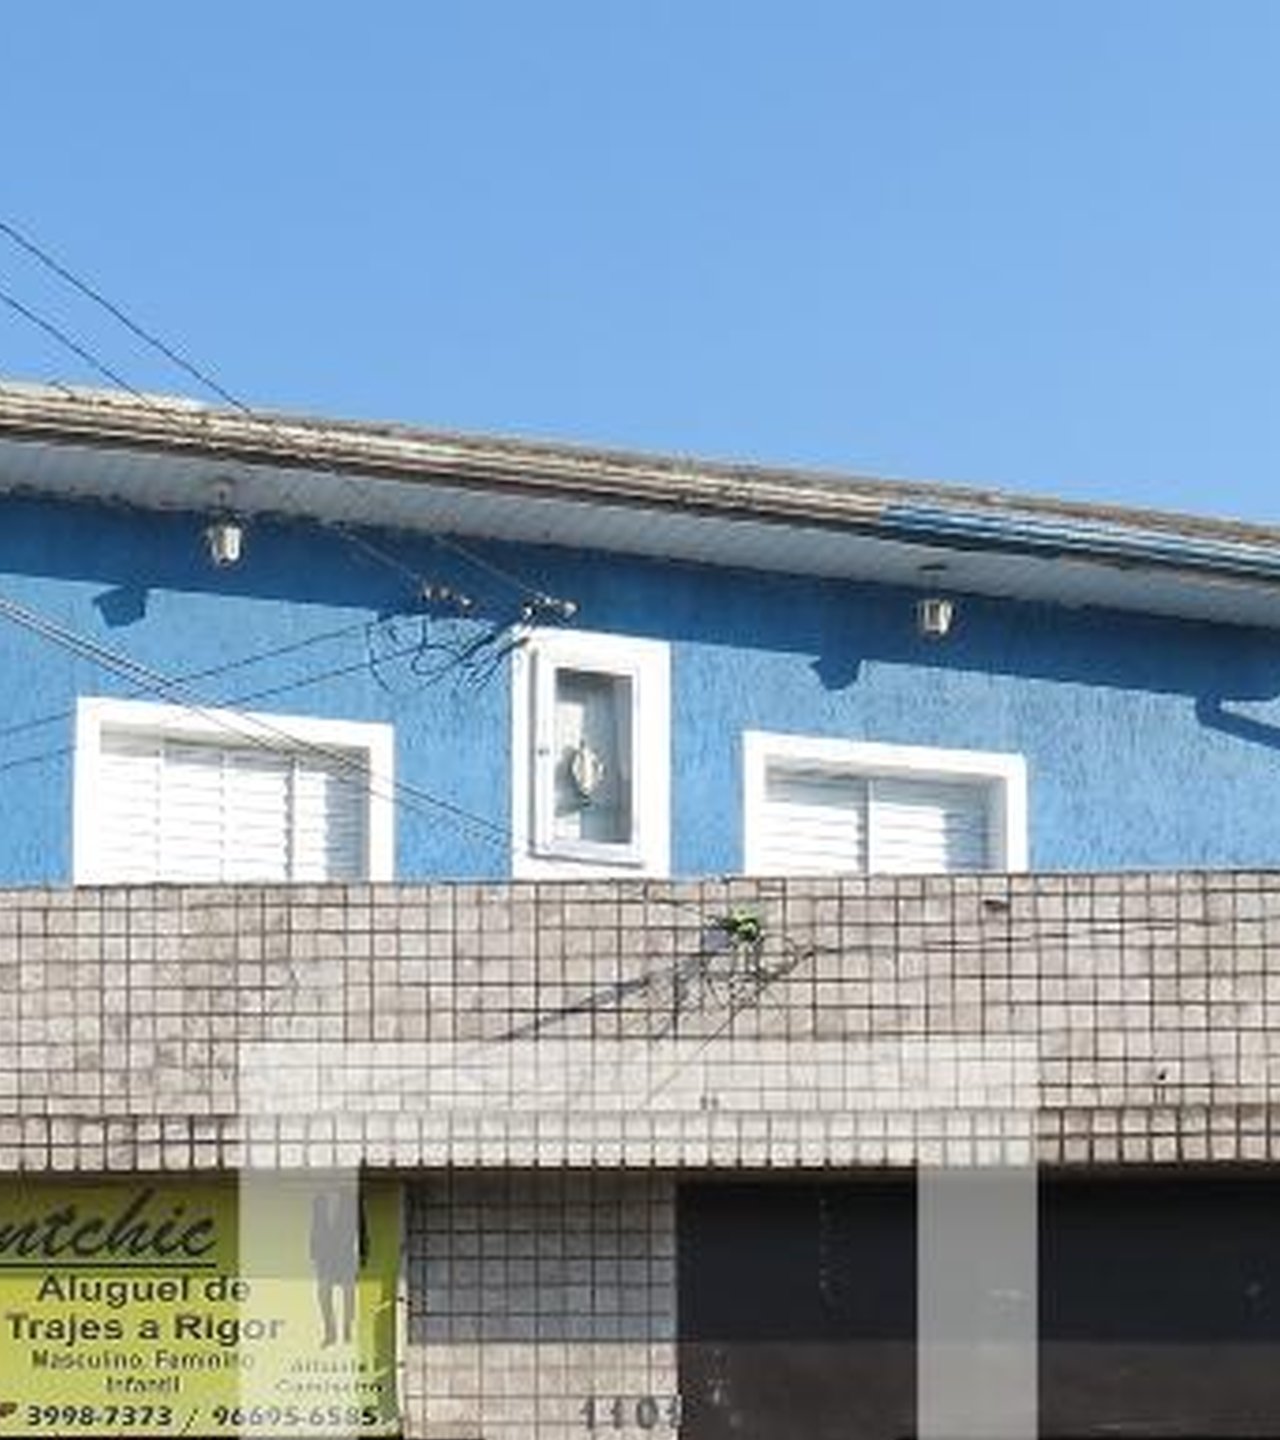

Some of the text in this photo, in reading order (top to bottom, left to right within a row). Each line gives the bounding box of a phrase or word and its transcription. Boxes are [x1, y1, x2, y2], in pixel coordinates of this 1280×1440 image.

[37, 1275, 250, 1309] Aluguel de
[5, 1313, 284, 1347] Trajes a Rigor
[106, 1375, 181, 1395] Infantil
